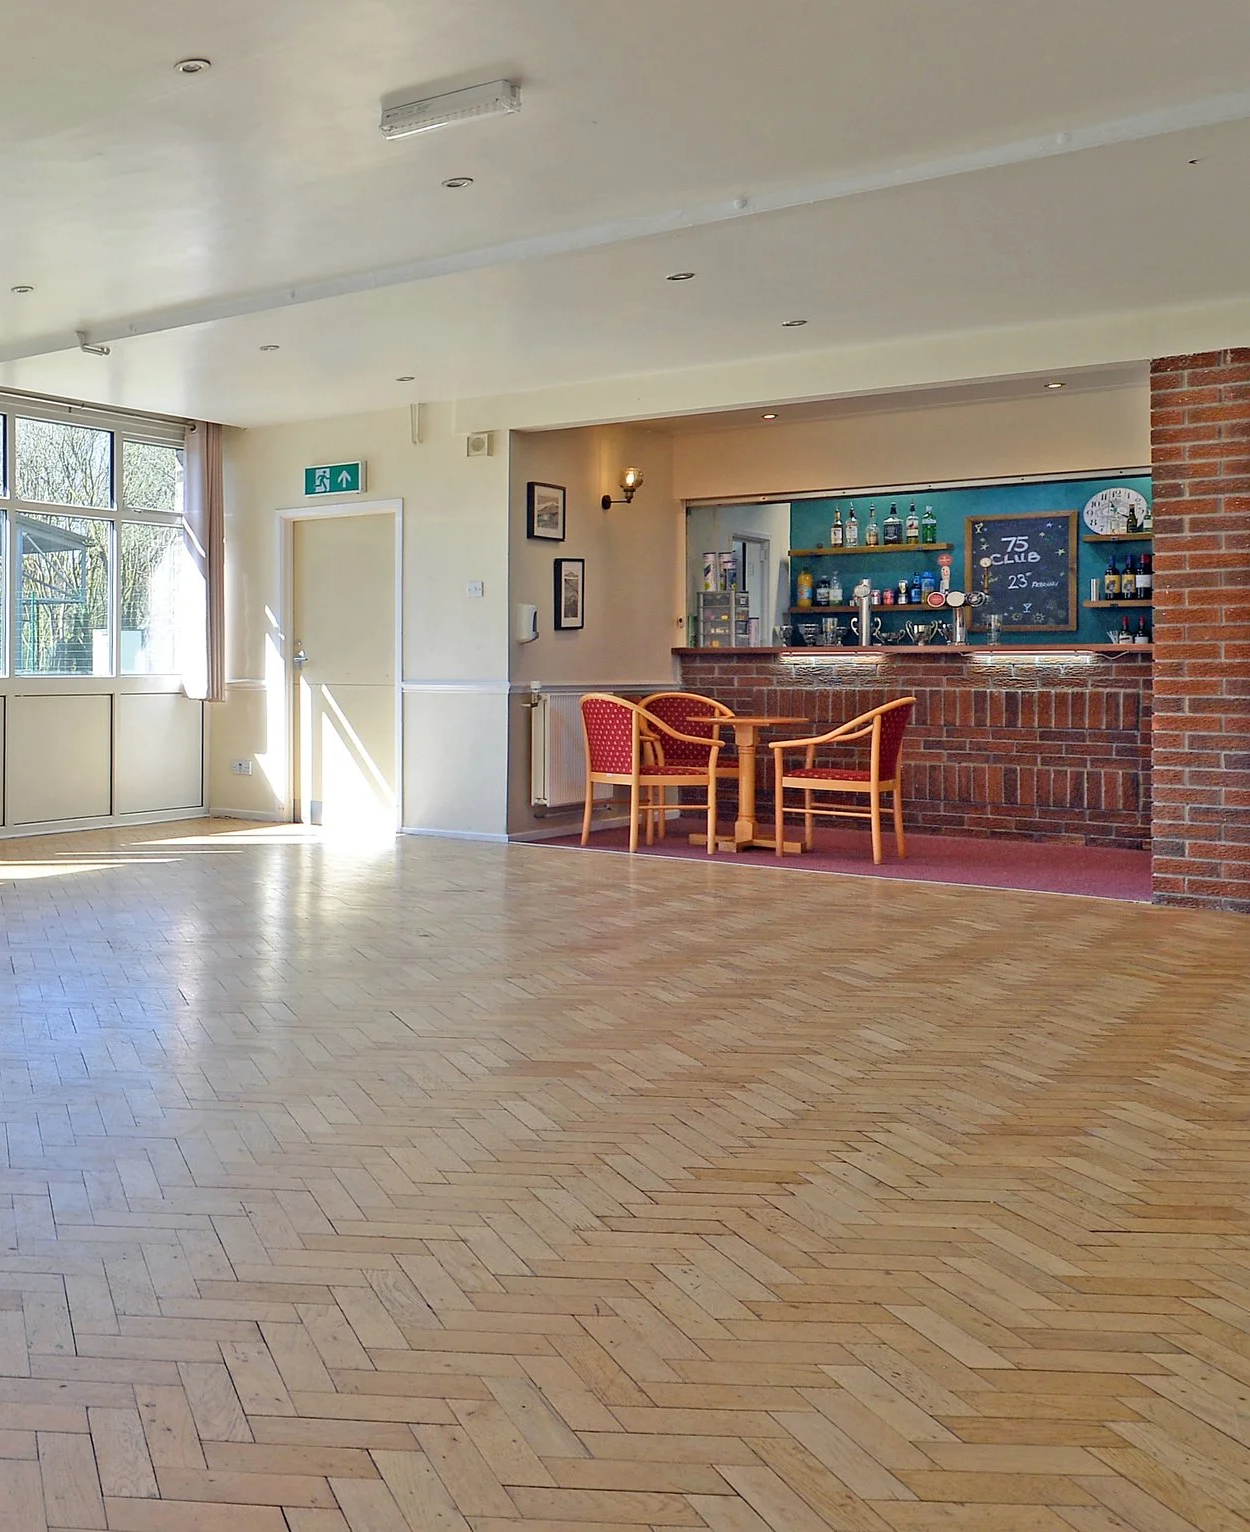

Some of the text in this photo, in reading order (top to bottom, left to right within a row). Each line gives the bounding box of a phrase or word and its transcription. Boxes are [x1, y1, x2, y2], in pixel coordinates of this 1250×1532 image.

[1111, 490, 1121, 498] 12
[1001, 536, 1029, 552] 75
[990, 551, 1041, 565] CLUB
